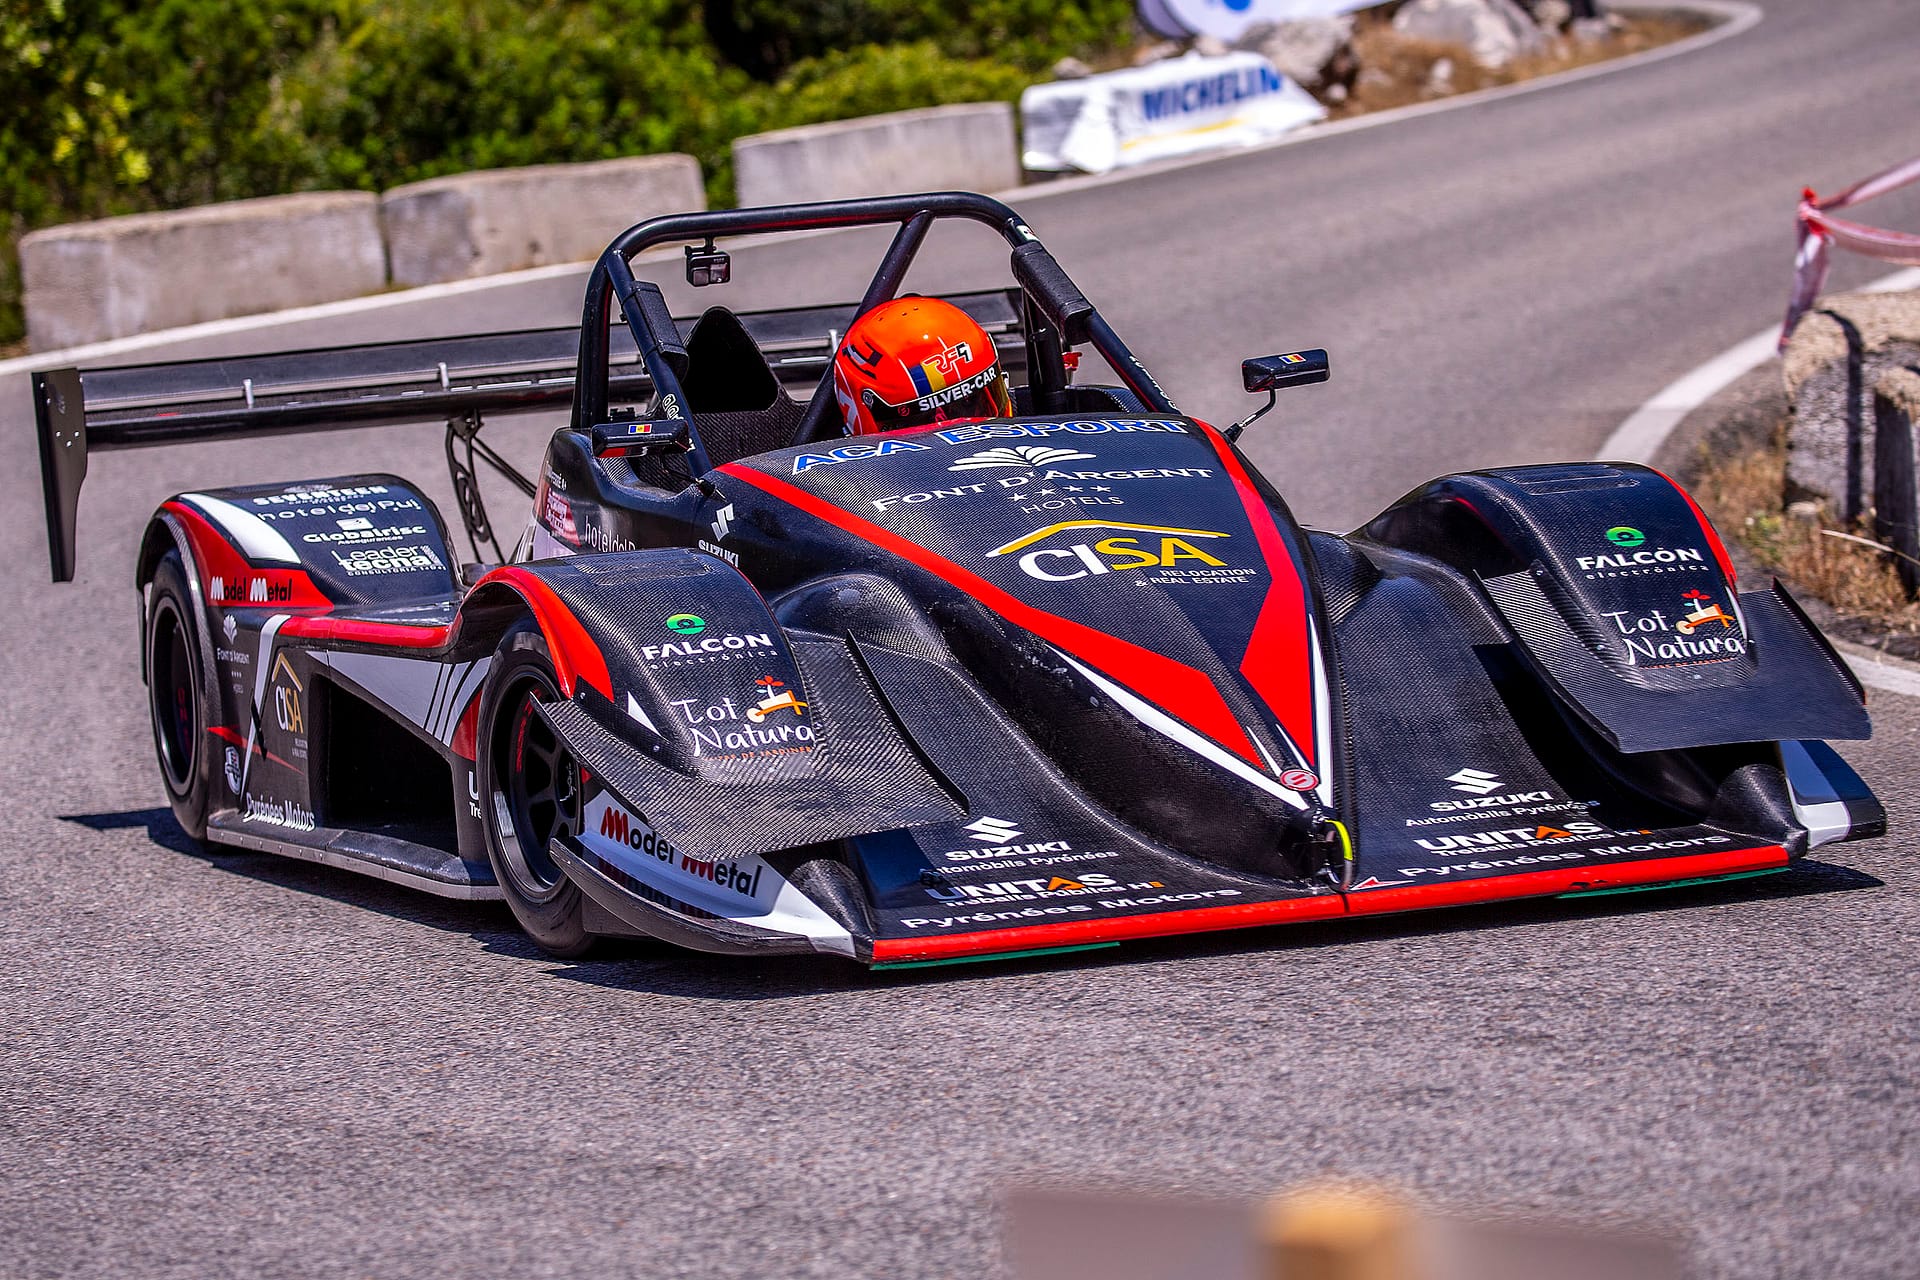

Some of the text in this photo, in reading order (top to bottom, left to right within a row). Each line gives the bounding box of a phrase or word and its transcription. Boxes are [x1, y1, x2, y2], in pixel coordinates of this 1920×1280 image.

[1143, 66, 1281, 121] MICHELIN
[919, 366, 997, 412] SILVER-CAR
[792, 419, 1189, 476] ACA ESPORT
[252, 486, 389, 507] SEVENTEEN
[871, 468, 1213, 513] FONT D'ARGENT
[1021, 496, 1125, 514] HOTELS
[331, 545, 418, 562] Leader
[338, 554, 432, 572] tecna
[698, 539, 739, 568] SUZUKI
[1018, 537, 1228, 582] CISA
[1135, 575, 1250, 588] & REAL ESTATE
[1160, 568, 1256, 577] RELOCATION
[211, 576, 292, 602] Model Metal
[1601, 609, 1671, 635] Tot
[1622, 635, 1746, 666] Natura
[275, 685, 304, 734] CISA
[670, 697, 740, 724] Tot
[688, 723, 816, 758] Natura
[1430, 790, 1554, 811] SUZUKI
[282, 799, 316, 832] Motors
[601, 806, 674, 865] Model
[1414, 822, 1604, 851] UNITAS
[945, 840, 1073, 861] SUZUKI
[1397, 835, 1732, 877] Pyrénées Motors
[924, 873, 1117, 900] UNITAS
[900, 888, 1243, 929] Pyrénées Motors
